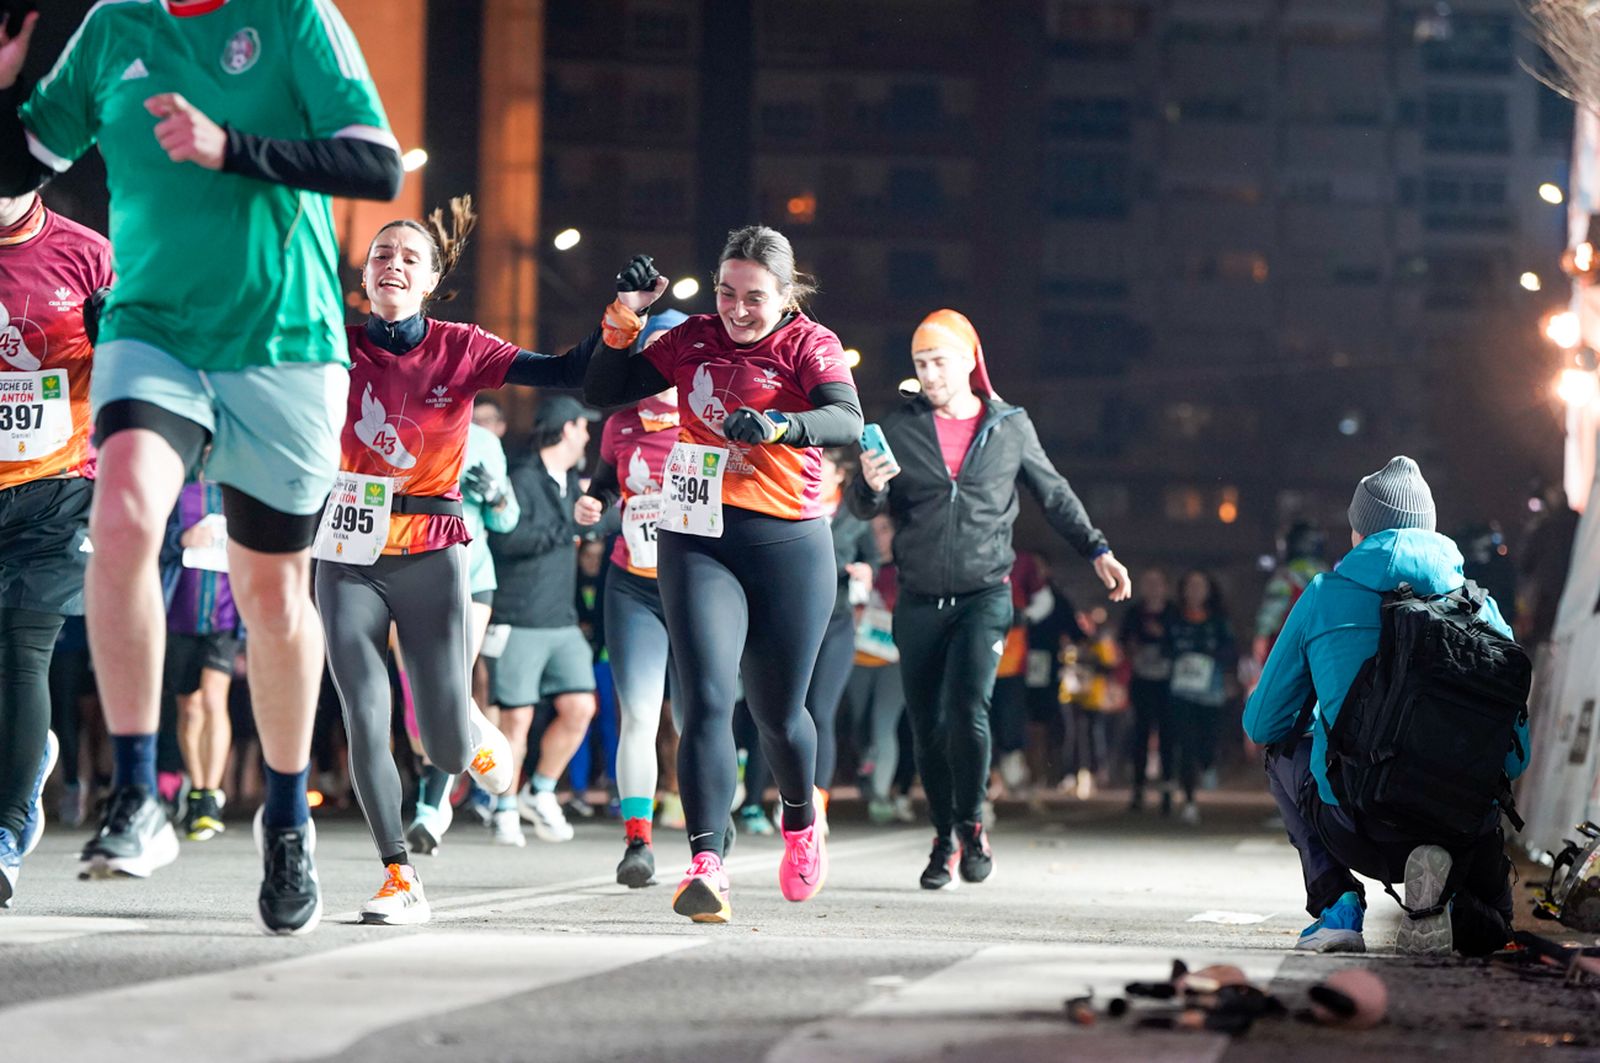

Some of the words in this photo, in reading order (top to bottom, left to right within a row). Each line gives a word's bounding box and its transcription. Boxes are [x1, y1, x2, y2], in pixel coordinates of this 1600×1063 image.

[22, 382, 34, 391] DE
[1, 391, 34, 403] ANTÓN
[0, 403, 43, 431] 397
[373, 431, 396, 455] 43
